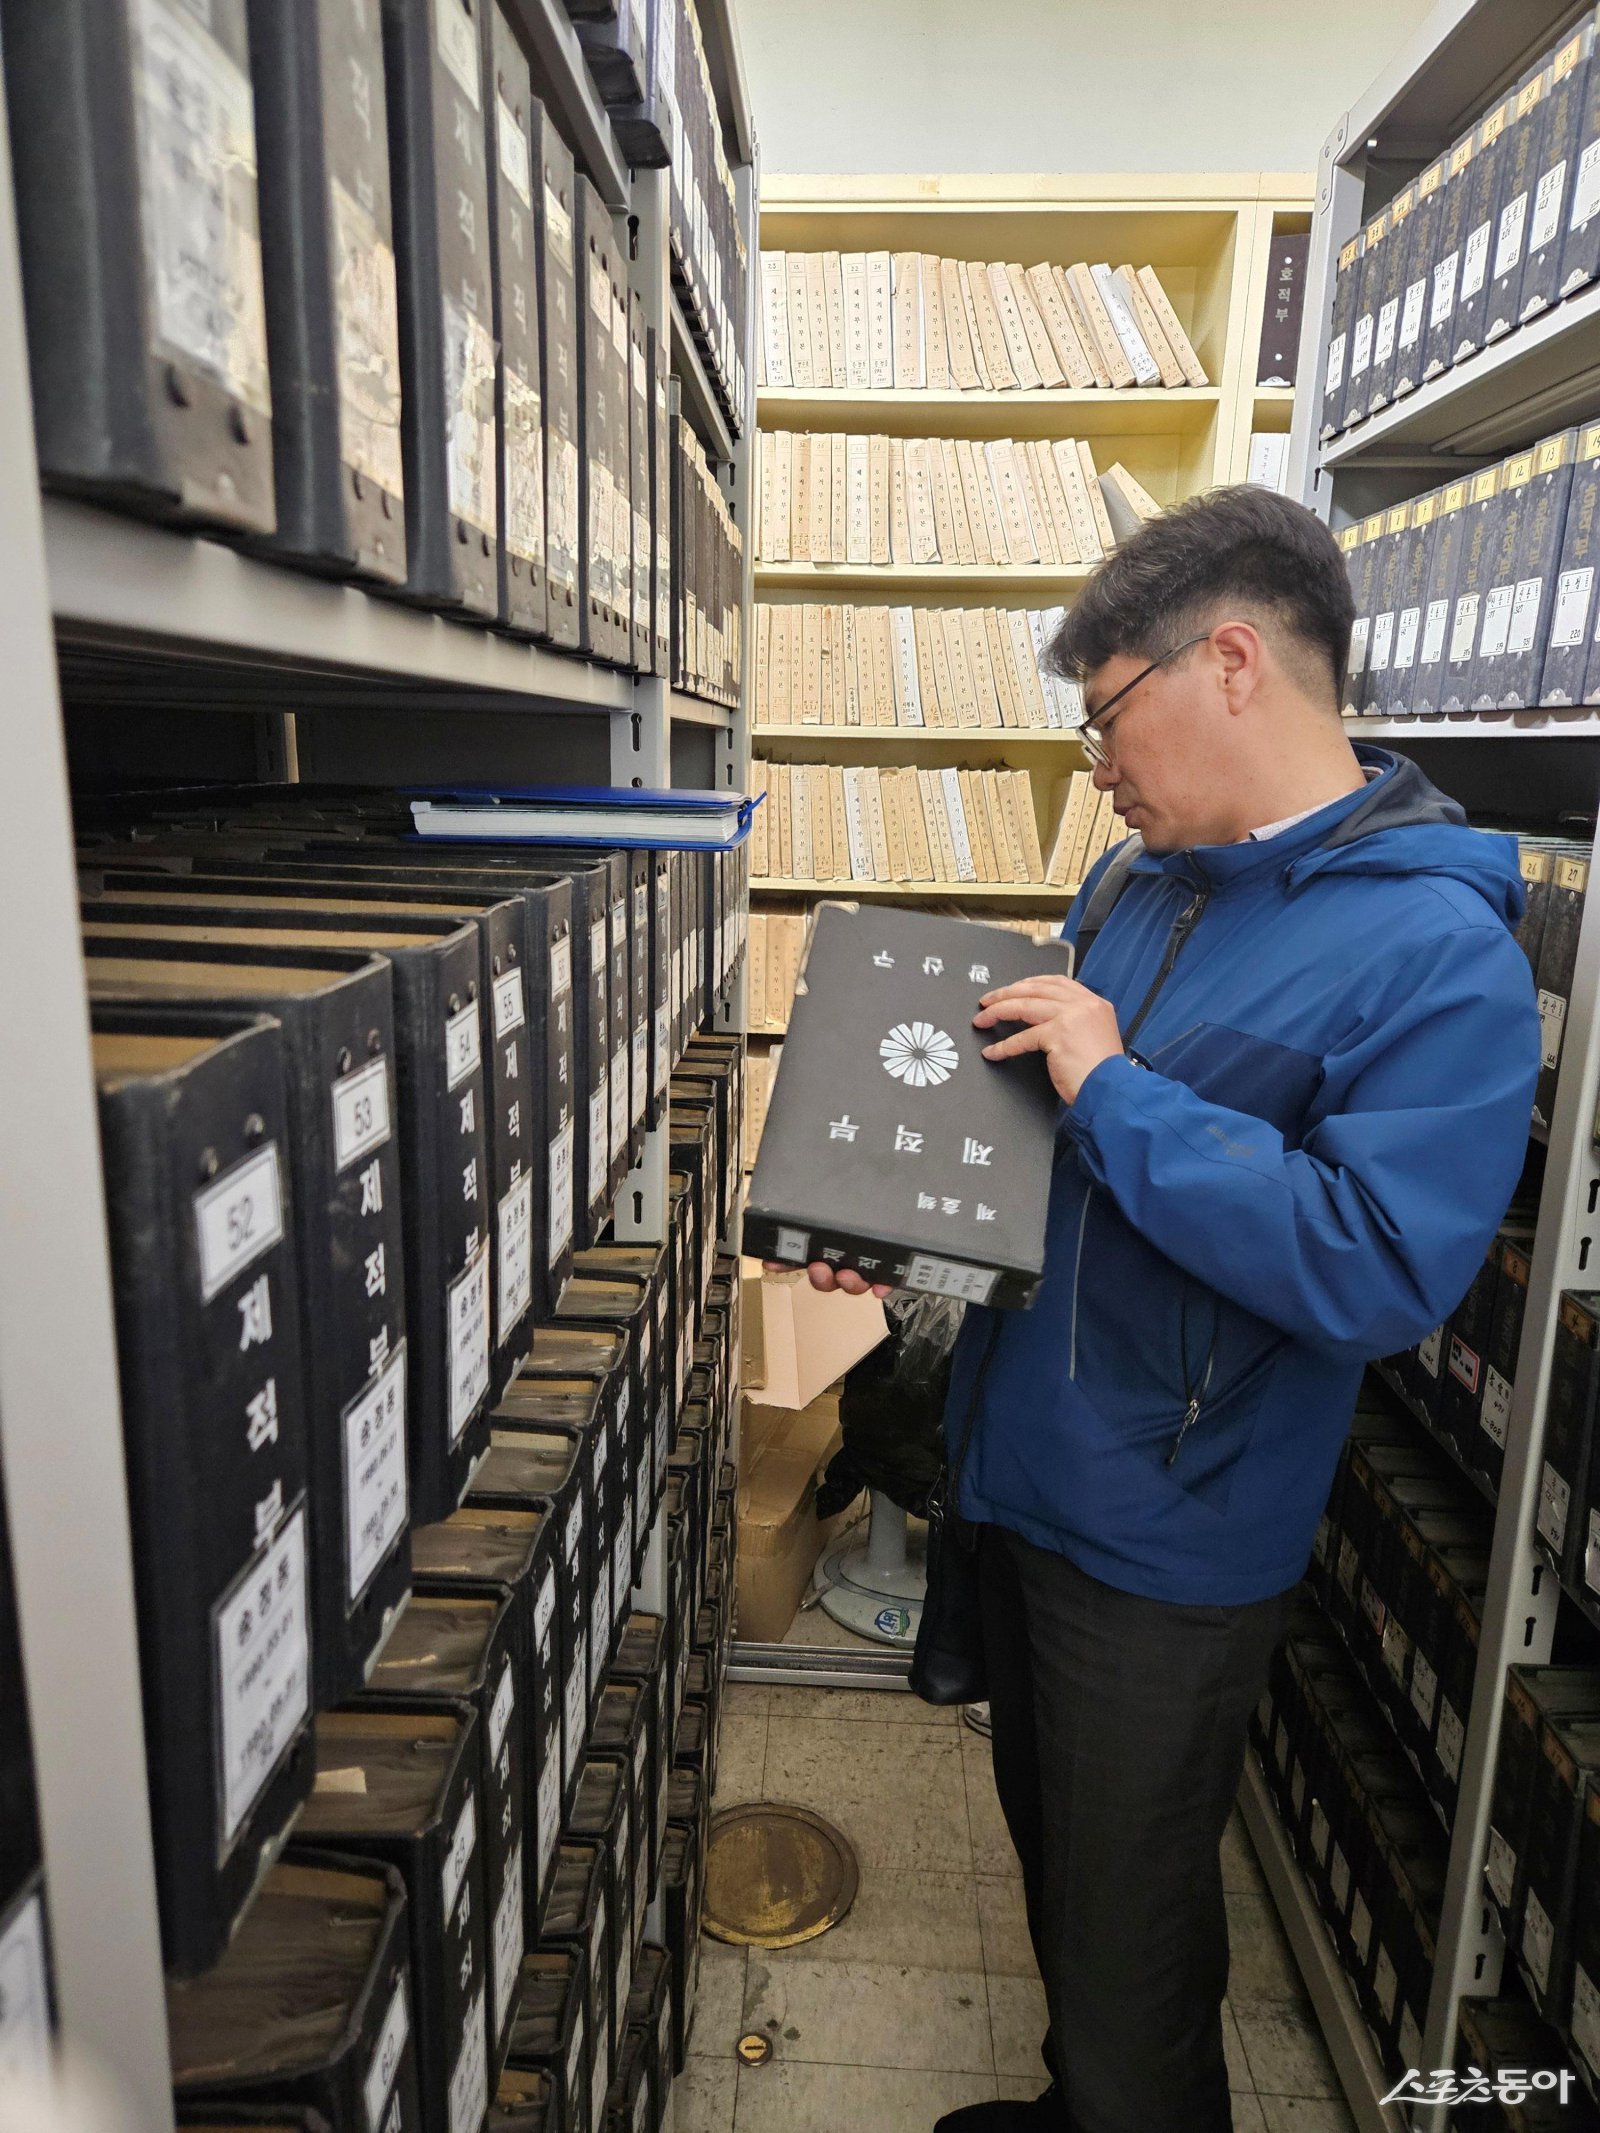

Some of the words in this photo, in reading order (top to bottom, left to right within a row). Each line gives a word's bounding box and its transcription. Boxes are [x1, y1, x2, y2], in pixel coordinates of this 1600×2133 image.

[1275, 267, 1294, 323] 호적부
[1567, 869, 1577, 882] 27
[873, 951, 992, 984] 광산구
[503, 992, 514, 1020] 55
[458, 1036, 472, 1062] 54
[558, 1001, 568, 1133] 제적부
[353, 1096, 373, 1138] 53
[829, 1114, 994, 1166] 제적부
[458, 1088, 480, 1264] 제적부
[226, 1195, 256, 1251] 52
[360, 1158, 390, 1379] 제적부
[237, 1273, 284, 1550] 제적부
[380, 2032, 397, 2086] 62
